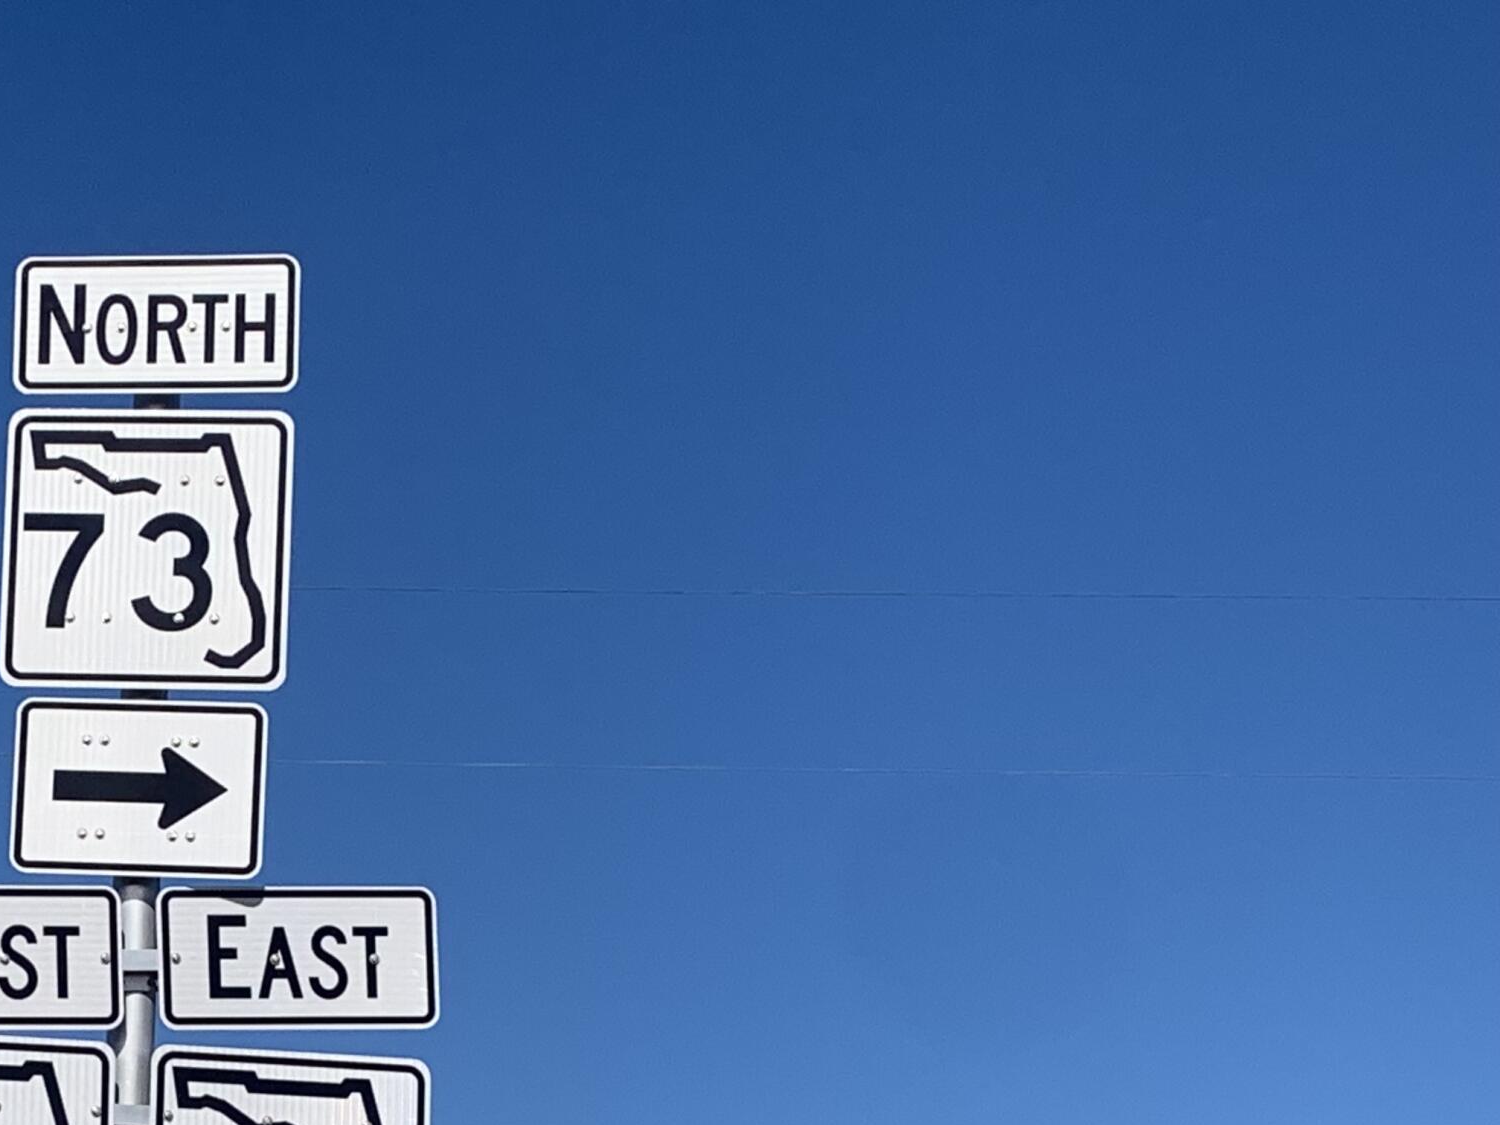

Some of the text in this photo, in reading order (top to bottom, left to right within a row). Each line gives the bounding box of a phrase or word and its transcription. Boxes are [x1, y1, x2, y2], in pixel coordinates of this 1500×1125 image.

[36, 283, 277, 366] NORTH
[22, 511, 214, 632] 73
[206, 914, 389, 1000] EAST
